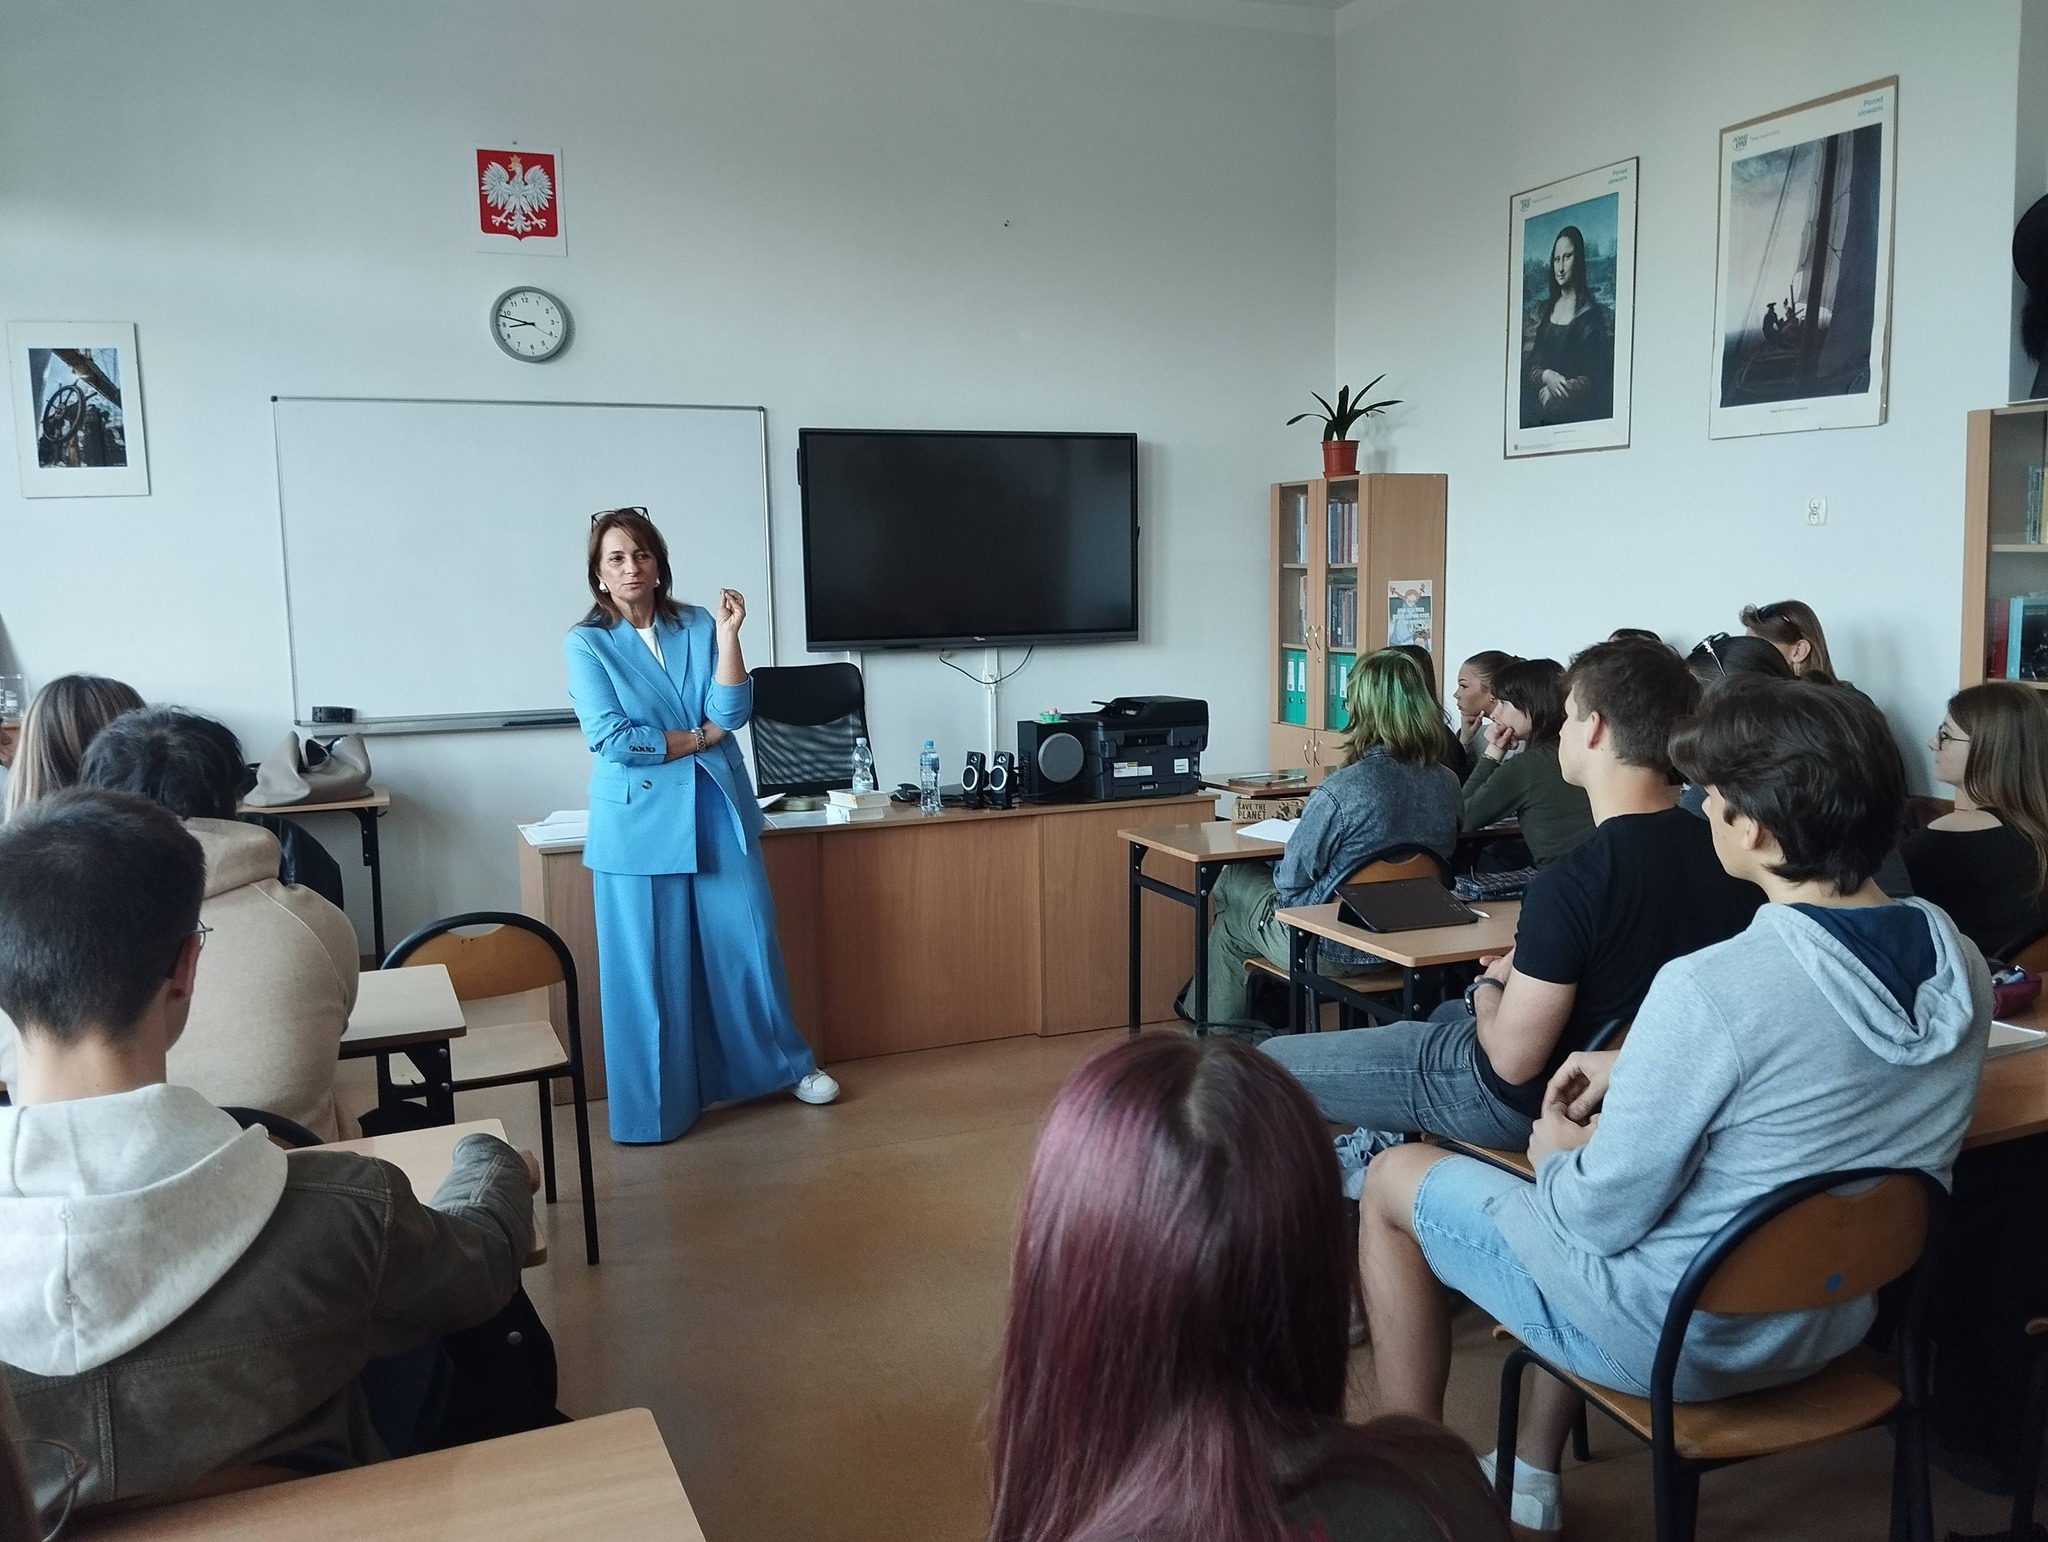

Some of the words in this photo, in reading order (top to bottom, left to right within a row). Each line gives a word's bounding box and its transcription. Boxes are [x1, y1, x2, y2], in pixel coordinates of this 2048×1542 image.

[1237, 803, 1253, 811] SAVE
[1255, 803, 1267, 811] THE
[1237, 810, 1267, 820] PLANET
